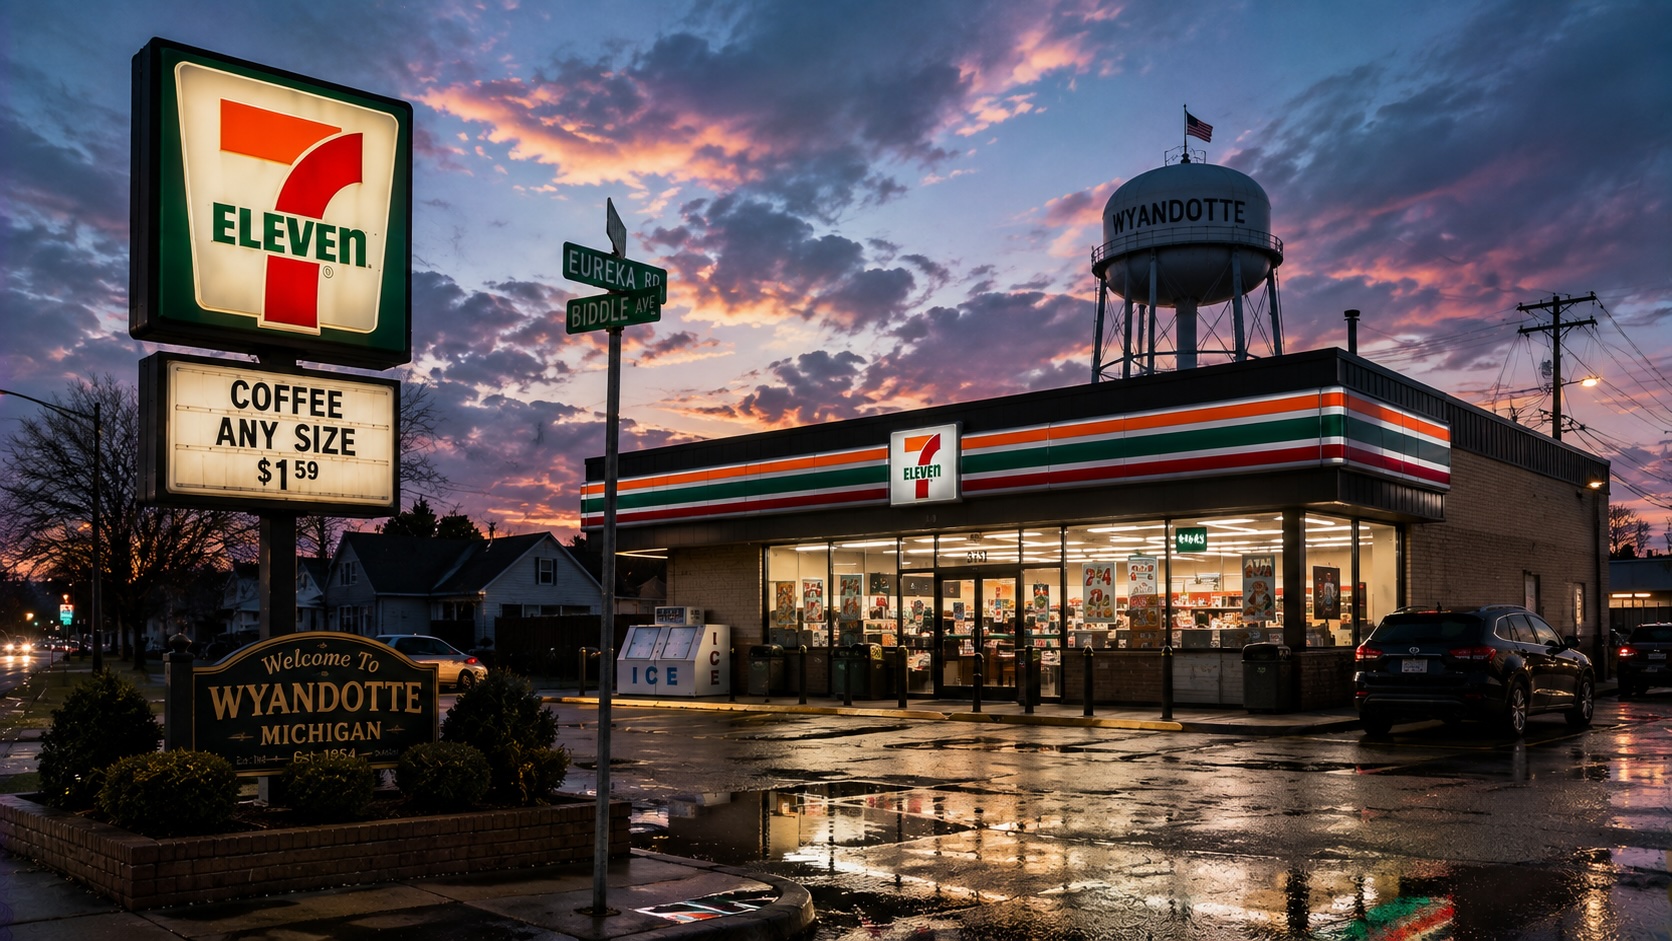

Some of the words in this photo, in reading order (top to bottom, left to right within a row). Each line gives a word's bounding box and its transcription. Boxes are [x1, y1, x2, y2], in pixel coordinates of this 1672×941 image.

[220, 98, 363, 328] 7
[1112, 198, 1246, 235] WYANDOTTE
[569, 249, 636, 290] EUREKA
[571, 296, 629, 328] BIDDLE
[635, 295, 655, 314] AVE
[230, 379, 343, 419] COFFEE
[215, 417, 278, 450] ANY
[294, 423, 356, 456] SIZE
[904, 433, 941, 499] 7
[261, 648, 351, 675] Welcome
[358, 651, 380, 673] To
[632, 665, 678, 686] ICE
[709, 632, 720, 686] ICE
[208, 680, 422, 720] WYANDOTTE
[260, 721, 382, 746] MICHIGAN
